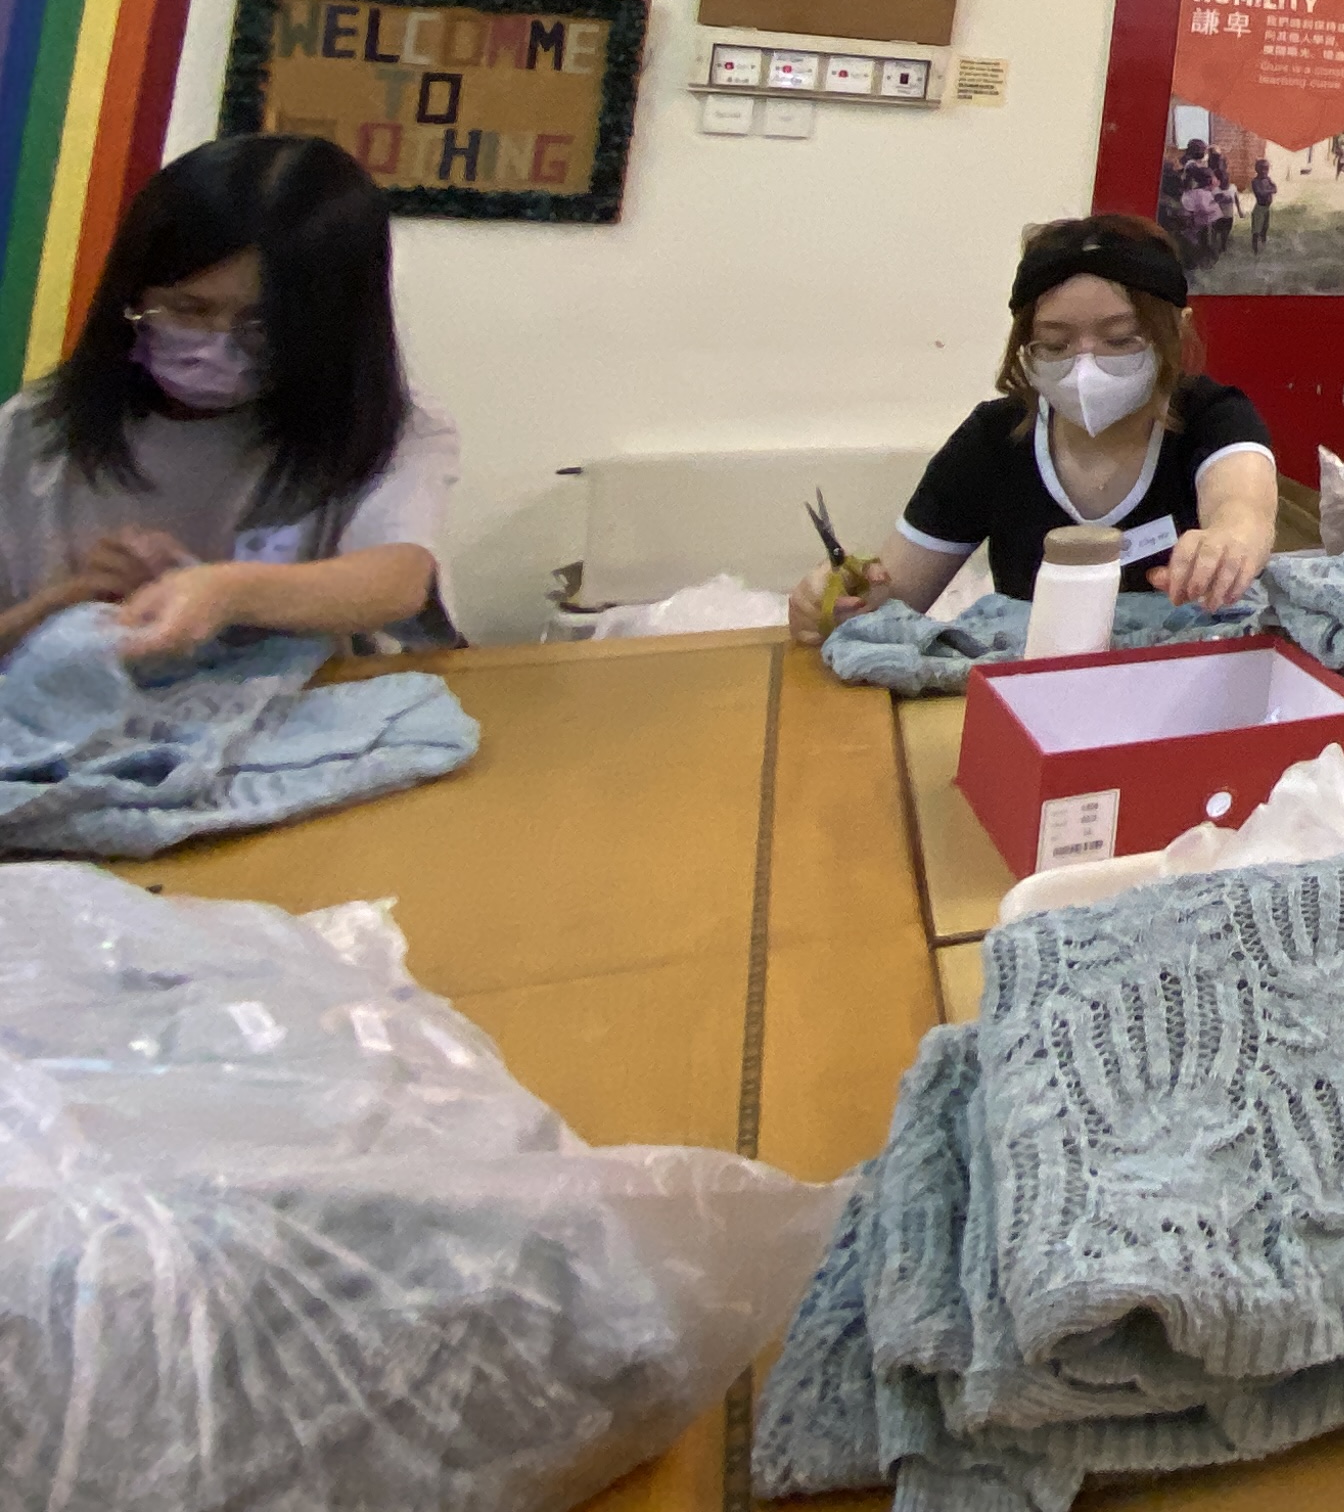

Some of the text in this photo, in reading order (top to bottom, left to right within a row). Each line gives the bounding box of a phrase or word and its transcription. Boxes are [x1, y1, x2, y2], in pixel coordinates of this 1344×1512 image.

[276, 0, 600, 74] WELCOMME
[1191, 8, 1252, 38] 謙卑
[374, 68, 463, 124] TO
